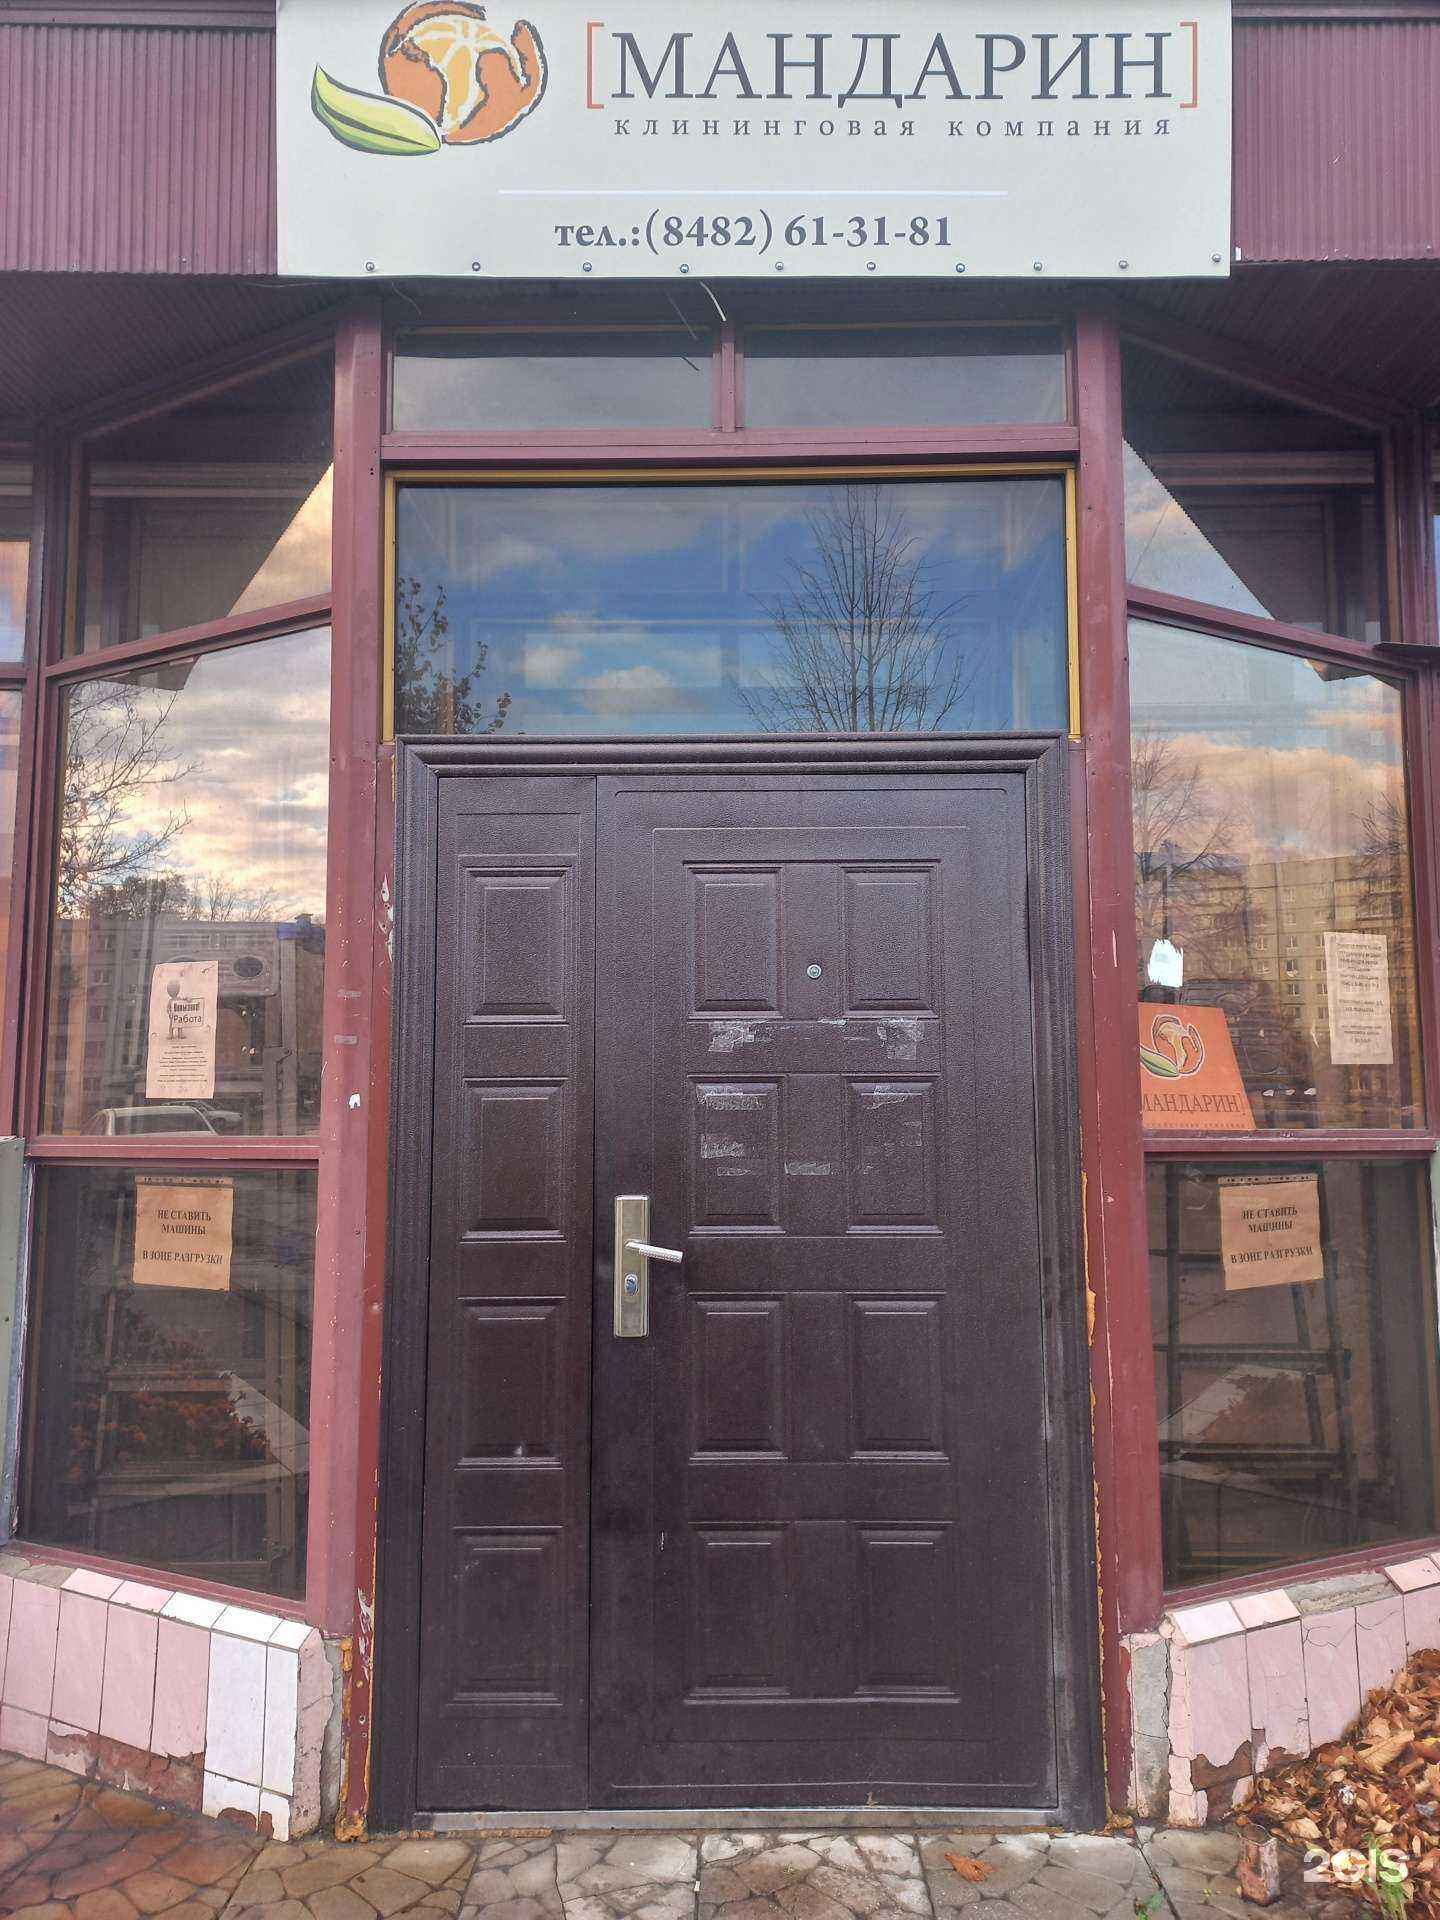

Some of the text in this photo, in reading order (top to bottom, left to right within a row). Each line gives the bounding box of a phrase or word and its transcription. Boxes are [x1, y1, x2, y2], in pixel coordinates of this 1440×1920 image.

[614, 119, 1170, 137] клининговая компания
[784, 214, 952, 248] 61-31-81
[173, 1014, 202, 1024] Работа
[157, 1209, 211, 1221] НЕ СТАВИТЬ
[1242, 1206, 1298, 1220] НЕ СТАВИТЬ
[161, 1223, 206, 1235] МАШИНЫ
[1248, 1220, 1293, 1233] МАШИНЫ
[143, 1250, 223, 1265] В ЗОНЕ РАЗГРУЗКИ
[1230, 1246, 1313, 1264] В ЗОНЕ РАЗГРУЗКИ
